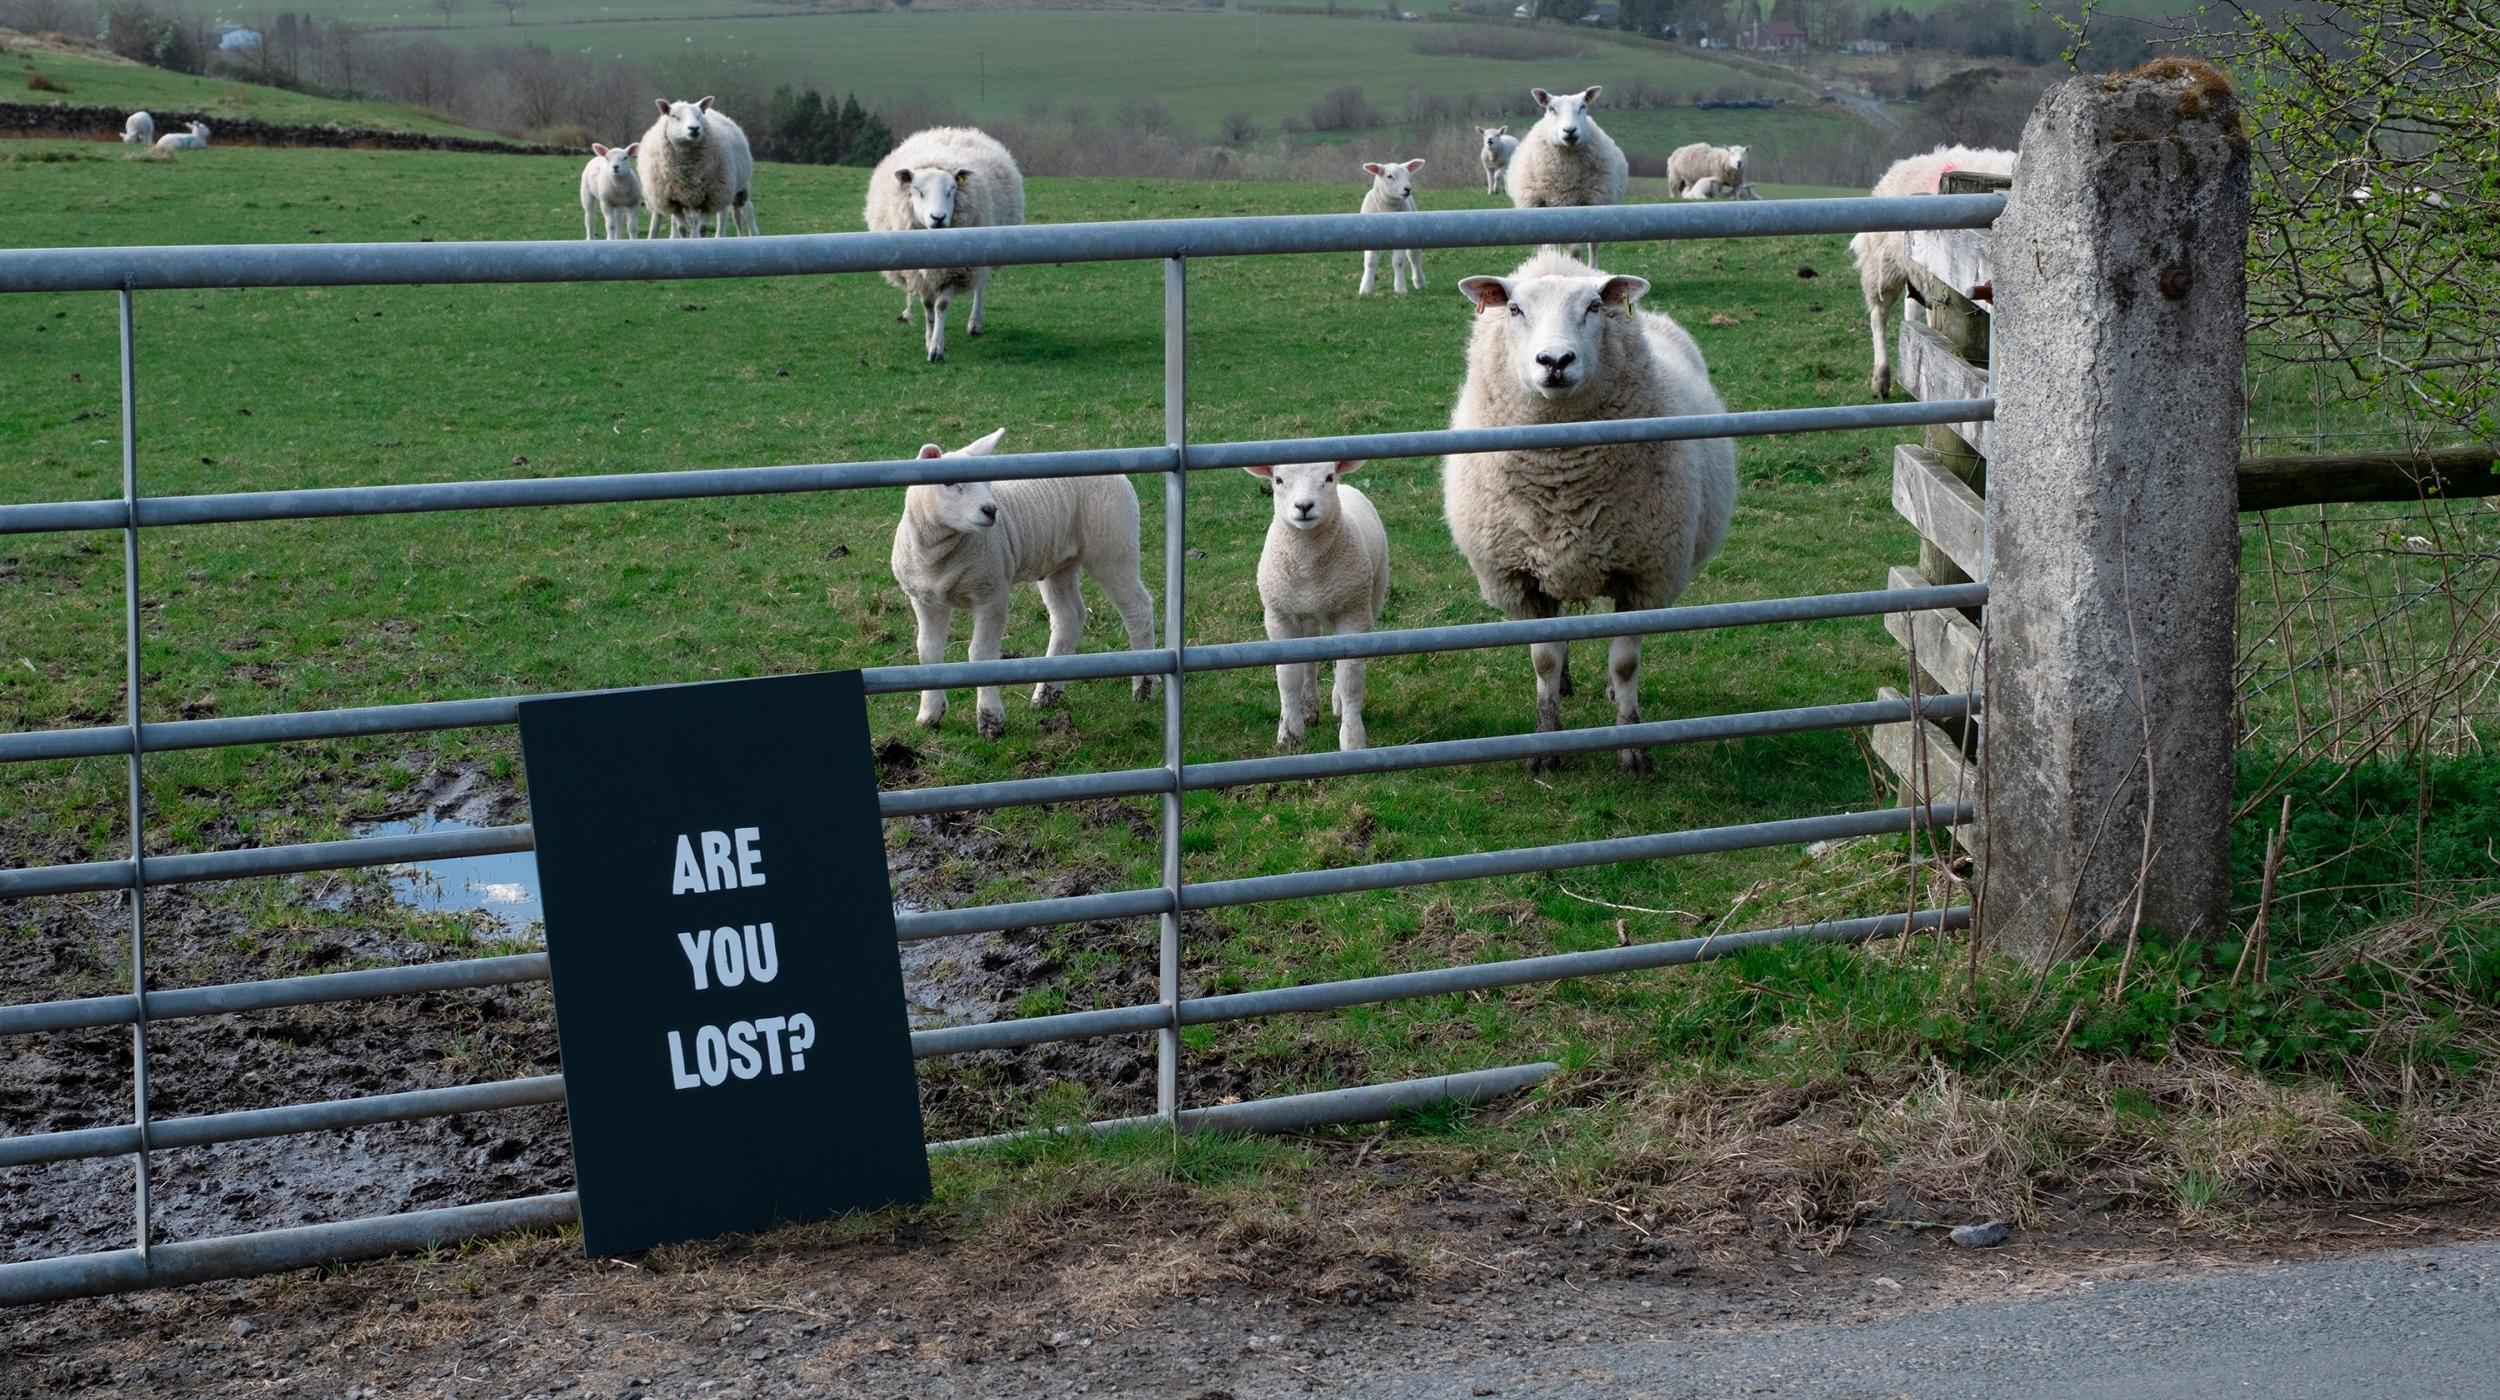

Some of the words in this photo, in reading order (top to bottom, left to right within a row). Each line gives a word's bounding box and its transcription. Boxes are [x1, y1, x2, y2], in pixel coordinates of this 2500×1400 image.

[672, 827, 766, 895] ARE
[677, 922, 778, 990] YOU
[667, 1012, 815, 1090] LOST?
